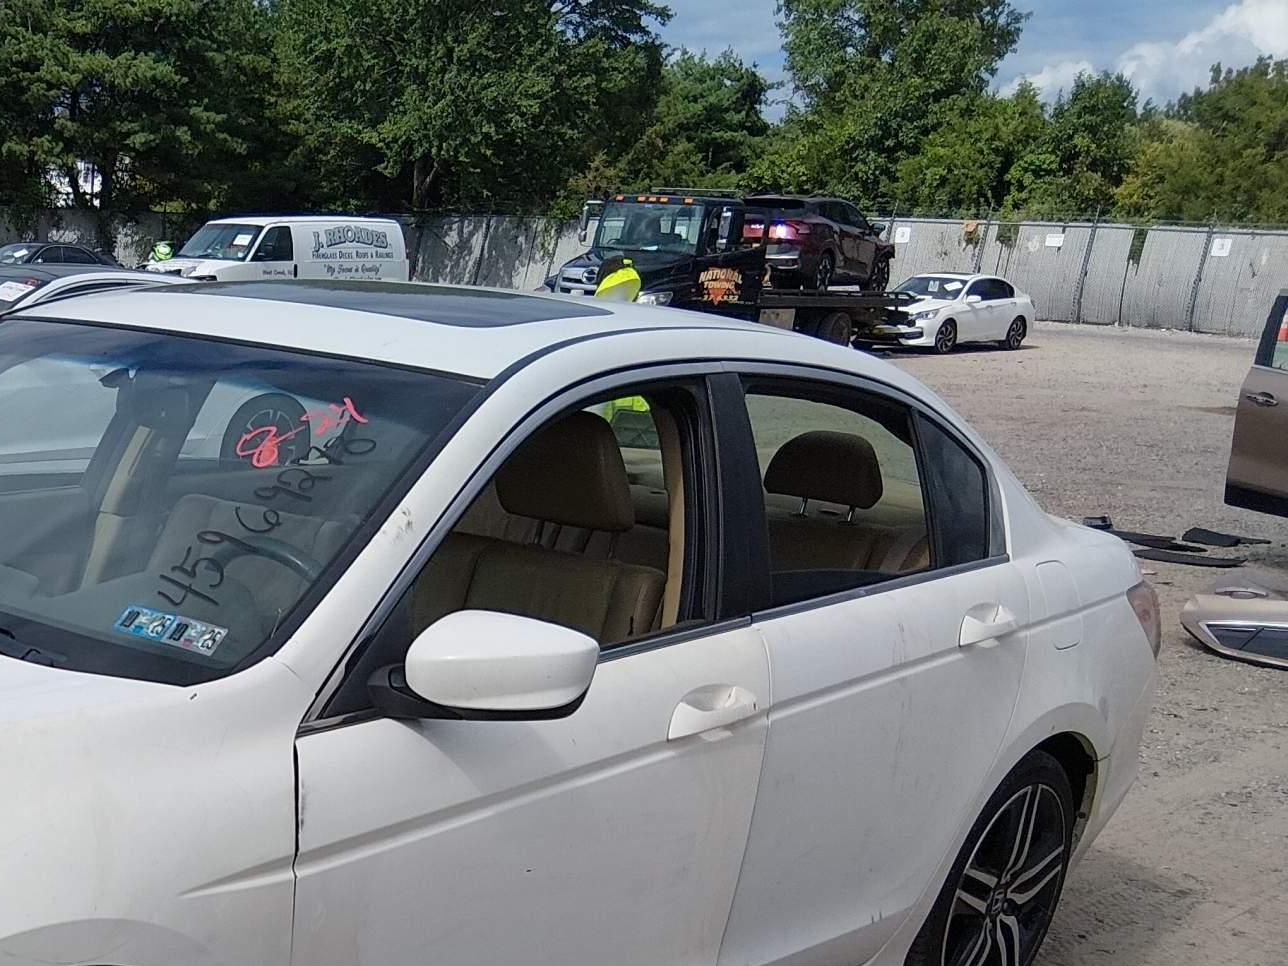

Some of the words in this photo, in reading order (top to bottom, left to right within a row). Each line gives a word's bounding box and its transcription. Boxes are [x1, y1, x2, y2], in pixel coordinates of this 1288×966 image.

[312, 231, 324, 252] J.
[324, 226, 388, 249] RHOADES
[698, 268, 744, 284] NATIONAL
[703, 281, 736, 289] TOWING
